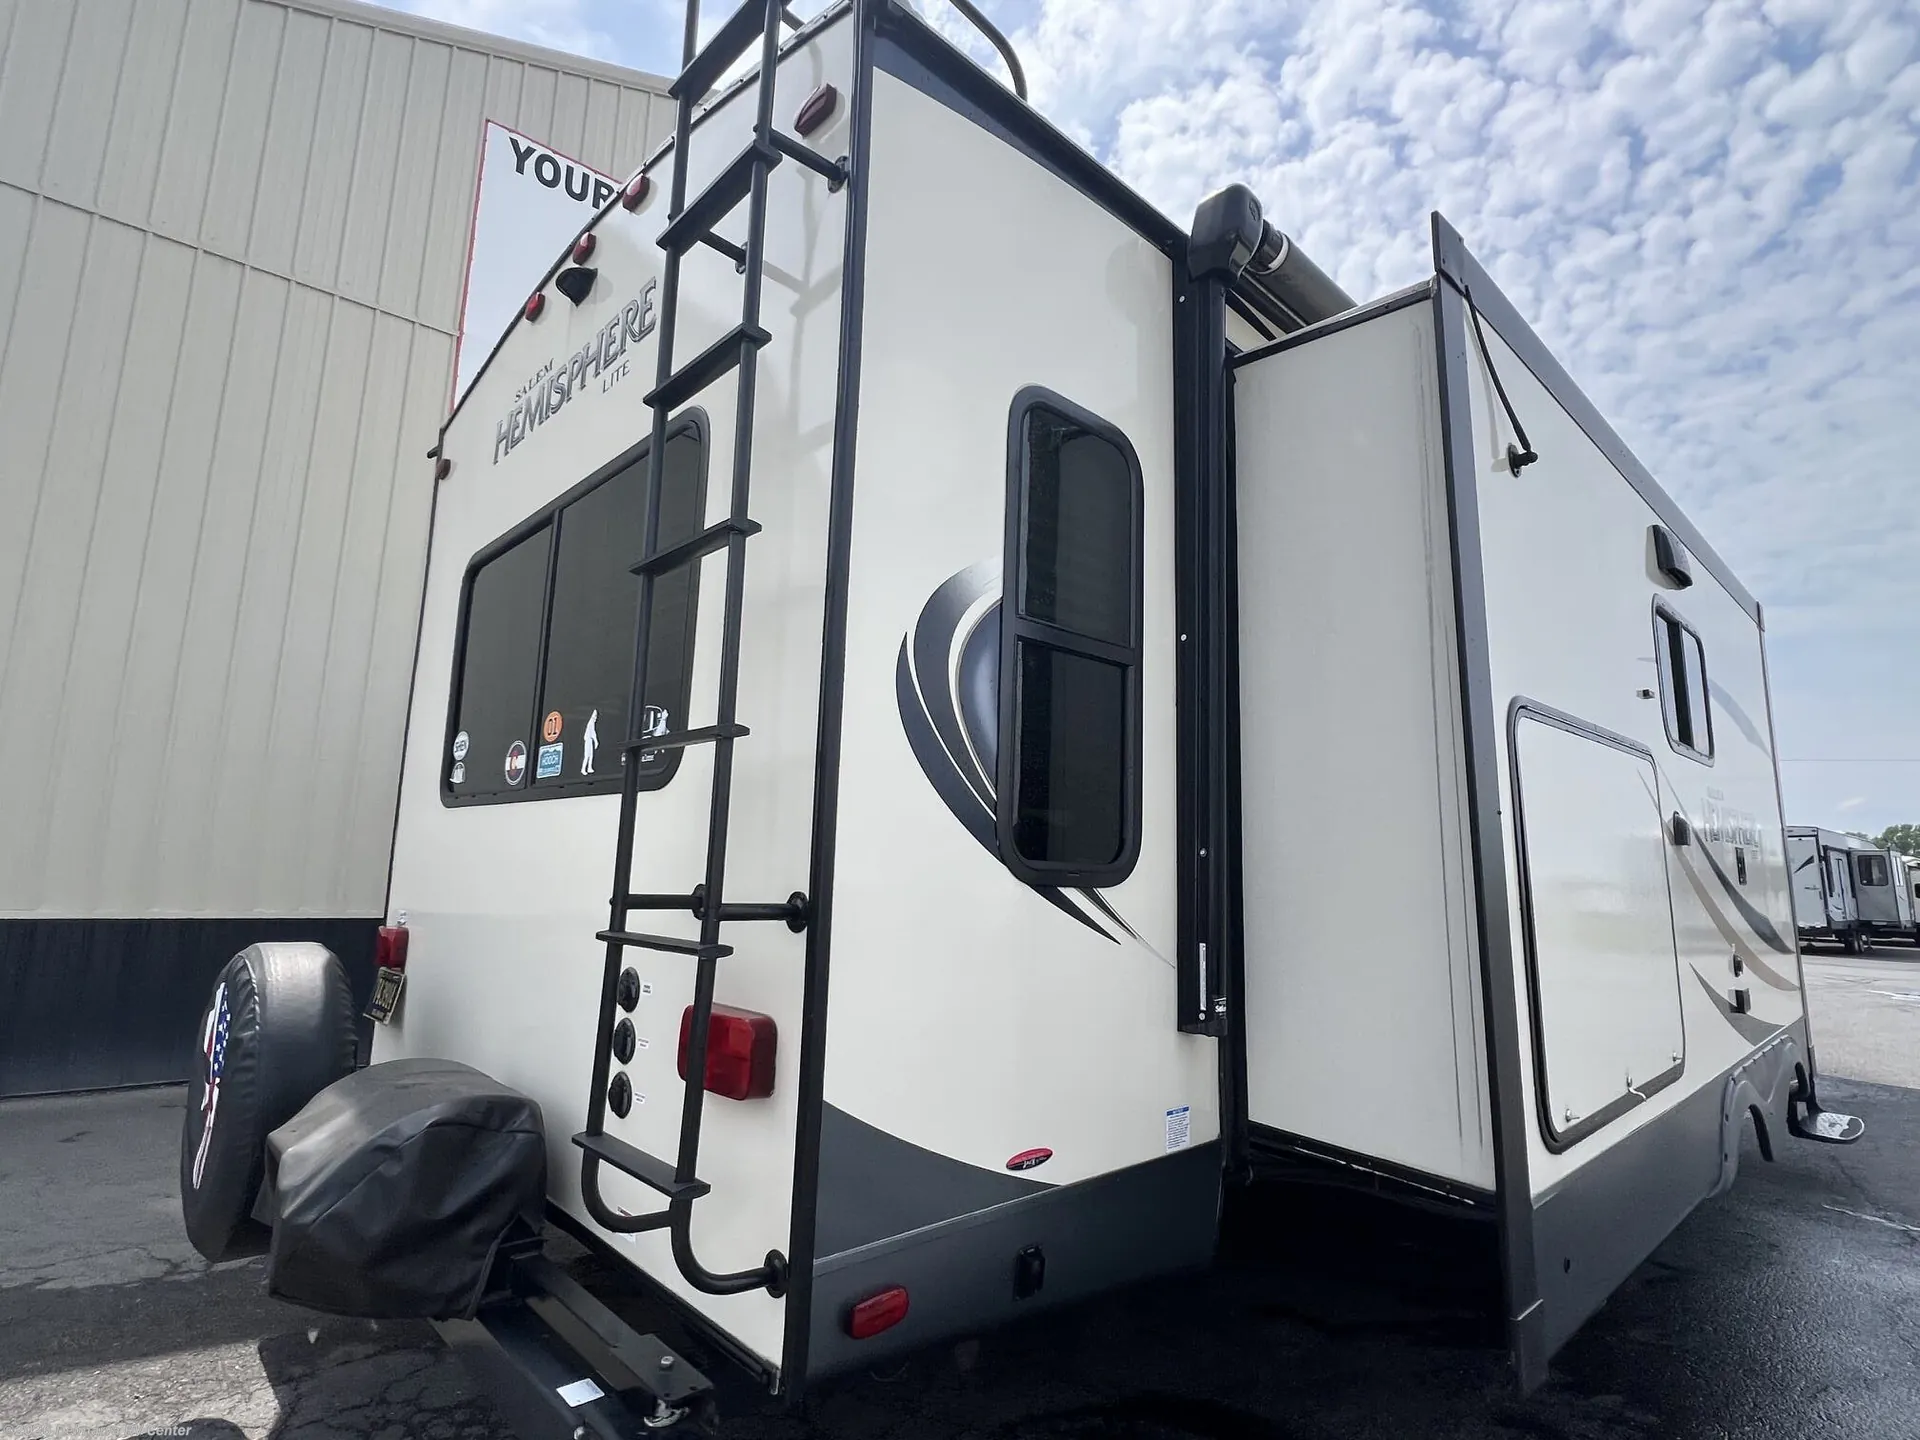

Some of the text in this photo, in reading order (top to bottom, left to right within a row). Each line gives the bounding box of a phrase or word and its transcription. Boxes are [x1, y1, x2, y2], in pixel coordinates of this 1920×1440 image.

[508, 136, 616, 210] YOUR
[492, 277, 657, 465] HEMISPHERE
[514, 357, 555, 403] SALEM
[602, 360, 631, 394] LITE
